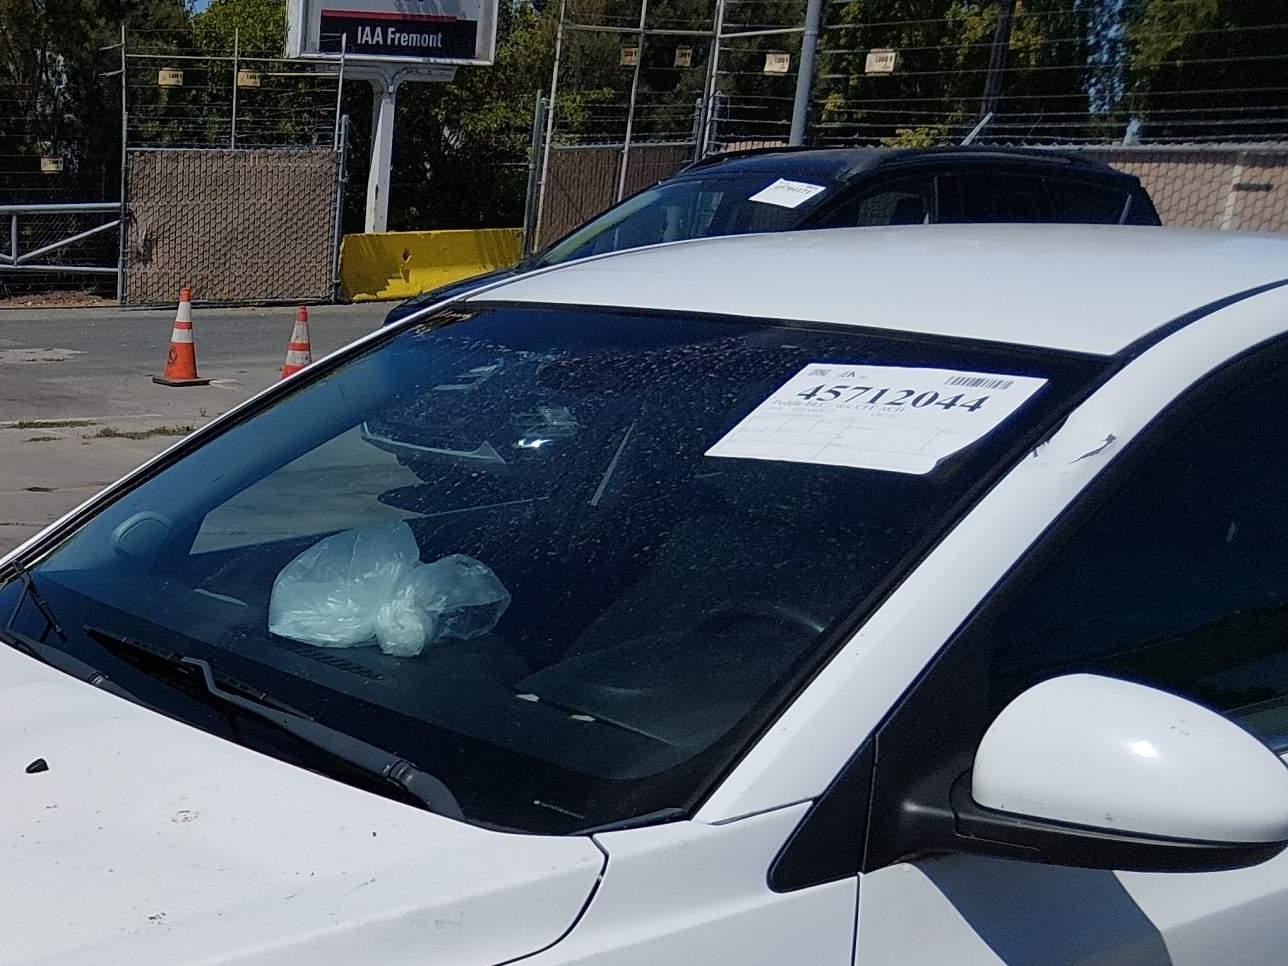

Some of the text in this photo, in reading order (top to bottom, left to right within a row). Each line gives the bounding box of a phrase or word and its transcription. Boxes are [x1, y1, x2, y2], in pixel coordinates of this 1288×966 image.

[357, 26, 442, 48] IAA Fremont
[797, 384, 990, 412] 45712044
